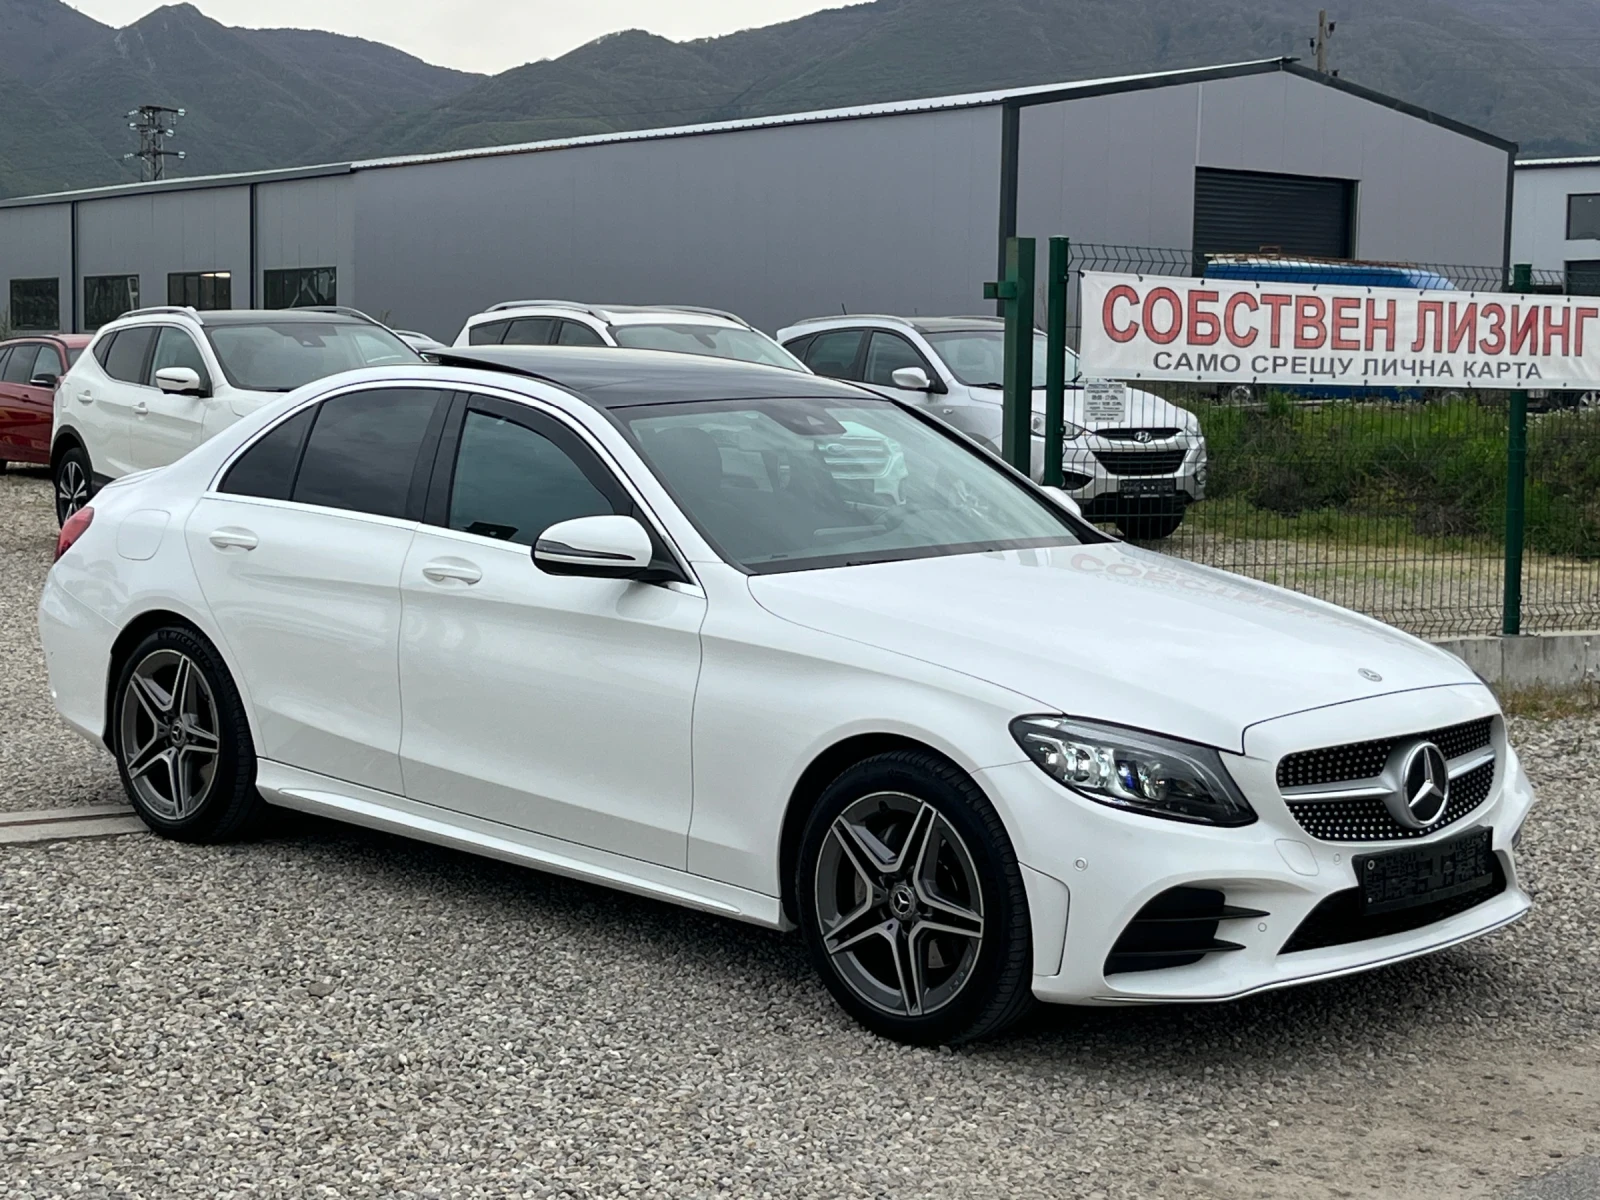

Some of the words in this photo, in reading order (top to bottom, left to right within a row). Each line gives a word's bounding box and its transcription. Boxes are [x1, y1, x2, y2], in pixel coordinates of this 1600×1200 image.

[1101, 284, 1397, 352] СОБСТВЕН
[1411, 300, 1598, 357] ЛИЗИНГ
[1152, 350, 1241, 373] САМО
[1251, 354, 1353, 379] СРЕЩУ
[1361, 358, 1454, 378] ЛИЧНА
[1463, 359, 1543, 380] КАРТА
[168, 631, 212, 668] MICHELIN
